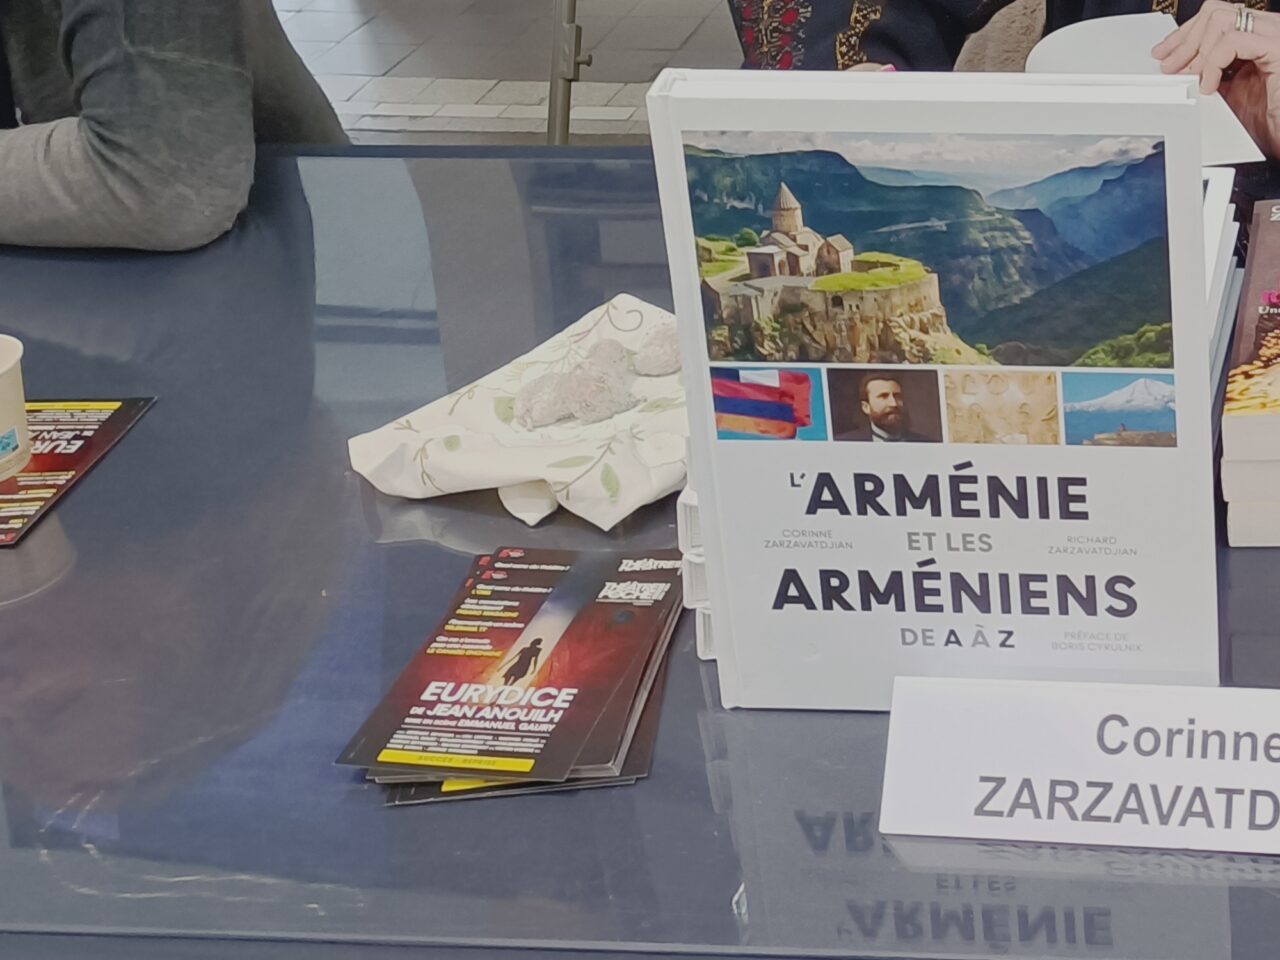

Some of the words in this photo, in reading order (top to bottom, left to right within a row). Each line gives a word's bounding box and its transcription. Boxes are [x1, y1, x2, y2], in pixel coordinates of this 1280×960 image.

[789, 460, 1090, 521] L'ARMÉNIE
[782, 529, 833, 539] CORINNE
[907, 531, 937, 552] ET
[946, 533, 993, 553] LES
[1066, 535, 1117, 545] RICHARD
[772, 557, 1138, 619] ARMÉNIENS
[901, 627, 935, 647] DE
[944, 628, 963, 648] A
[998, 630, 1016, 649] Z
[420, 681, 579, 708] EURYDICE
[426, 703, 475, 718] JEAN
[475, 705, 564, 723] ANOUILH
[457, 720, 517, 731] EMMANUEL
